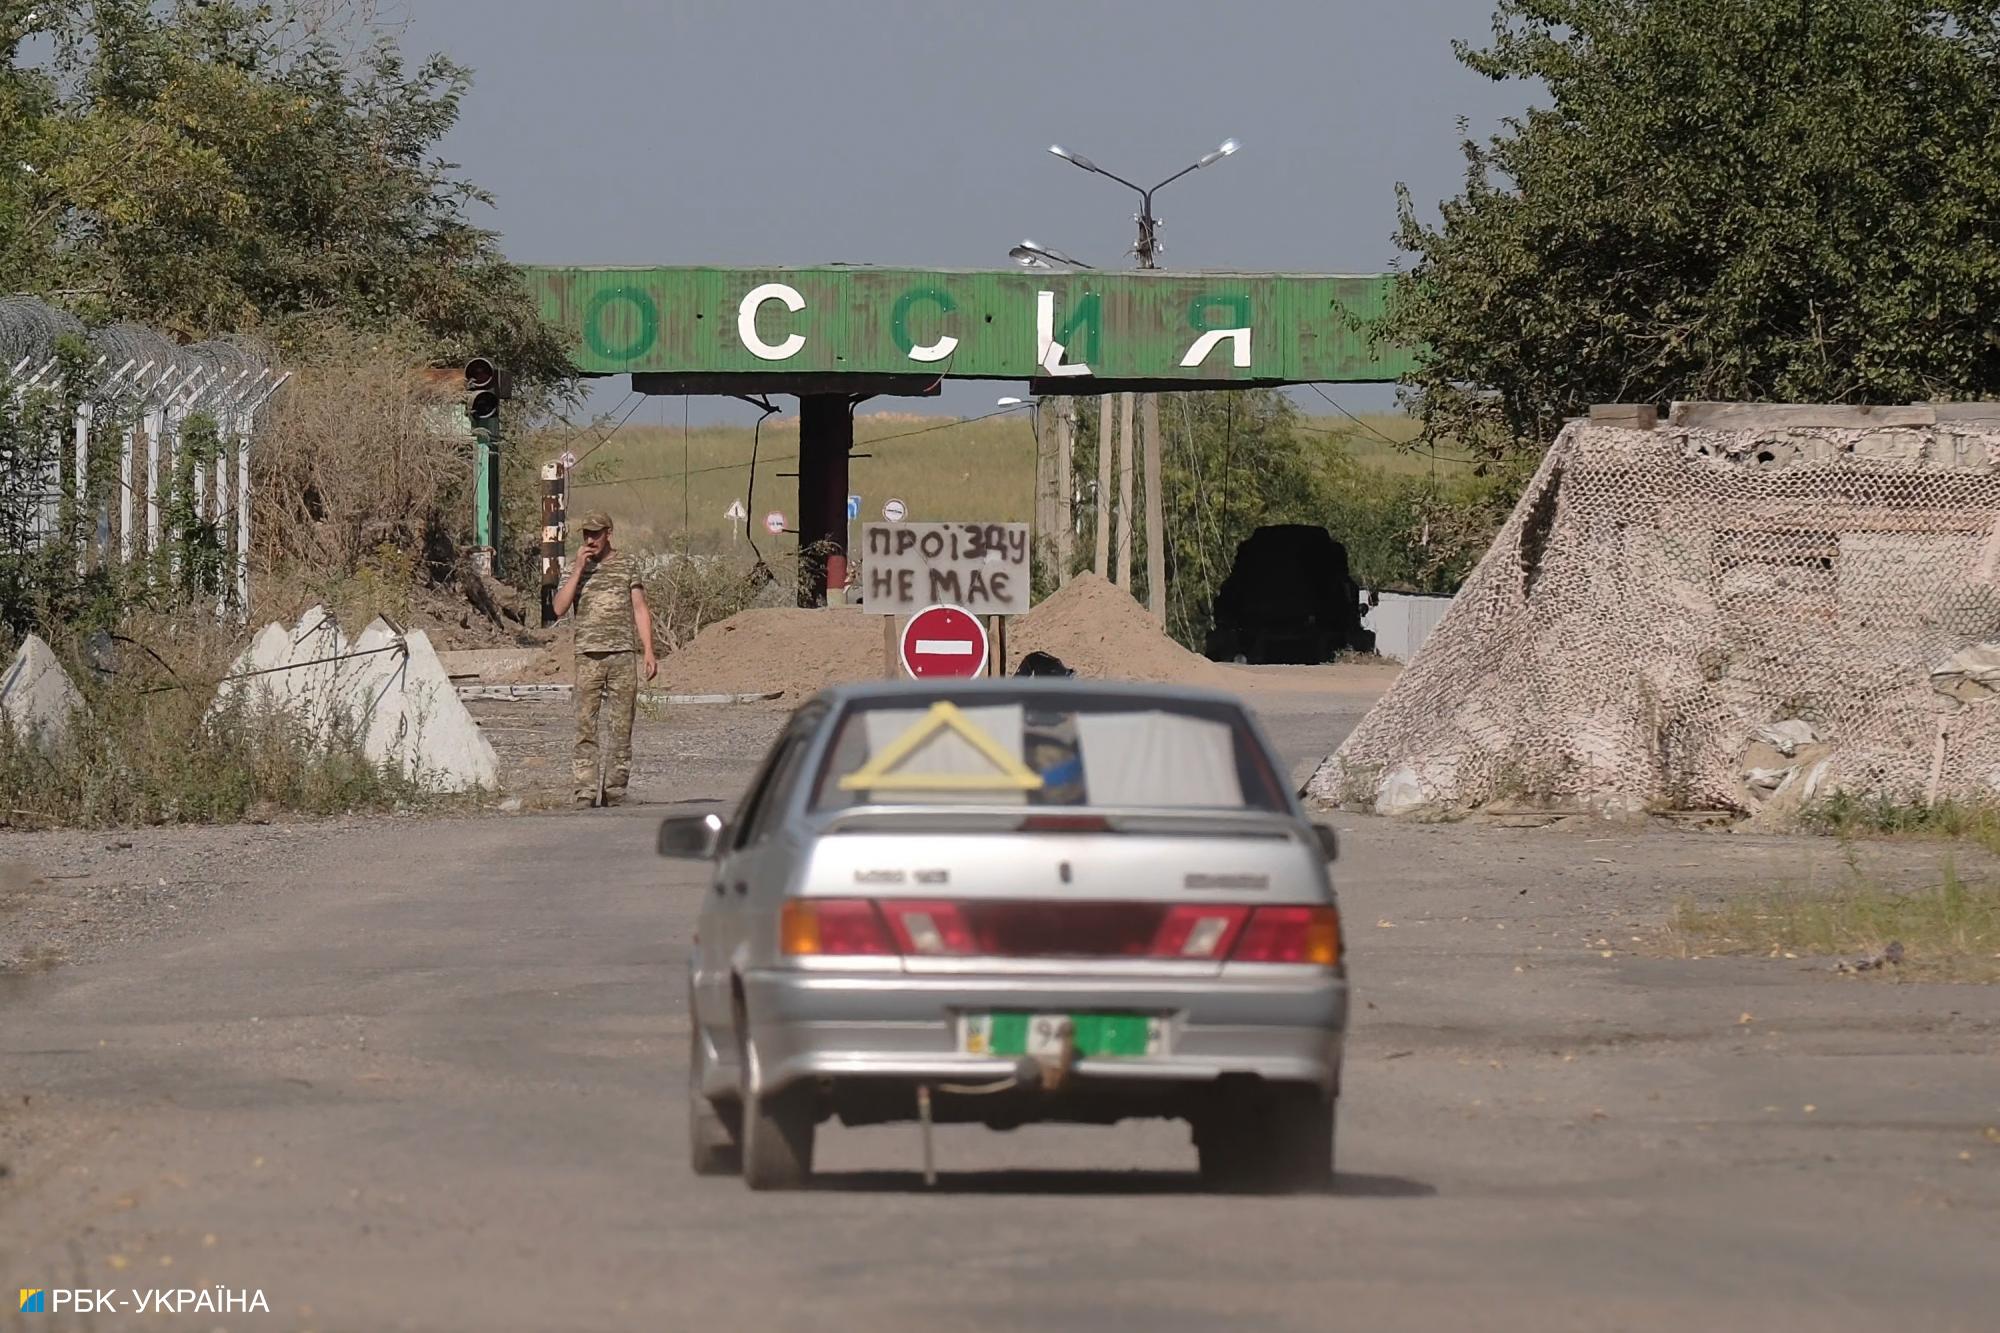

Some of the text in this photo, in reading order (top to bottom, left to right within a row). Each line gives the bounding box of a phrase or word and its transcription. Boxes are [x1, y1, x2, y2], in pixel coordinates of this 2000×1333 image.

[870, 524, 1026, 564] ПРОЇЗДУ
[873, 567, 1013, 603] НЕ МАЄ
